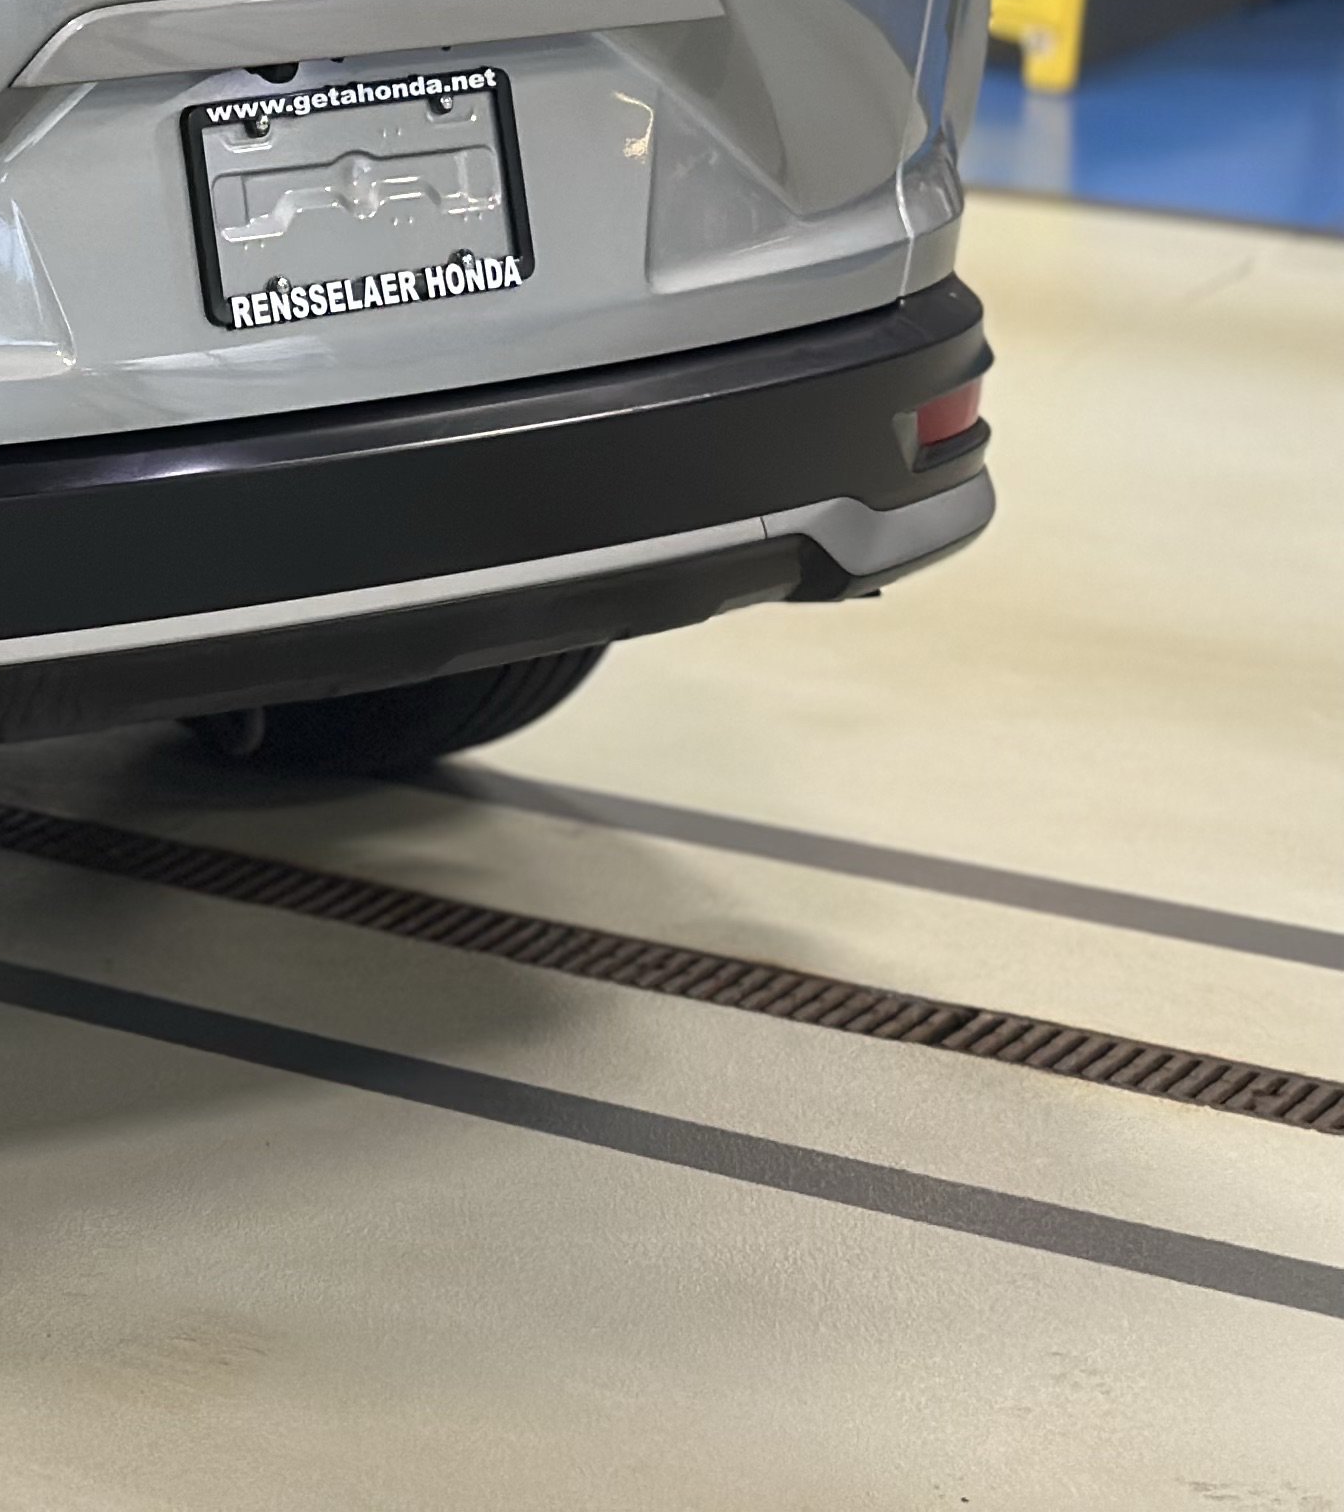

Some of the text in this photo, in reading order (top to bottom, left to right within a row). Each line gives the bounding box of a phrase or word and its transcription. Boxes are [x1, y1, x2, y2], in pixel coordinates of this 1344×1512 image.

[207, 68, 497, 122] www.getahonda.net
[231, 255, 523, 328] RENSSELAER HONDA
